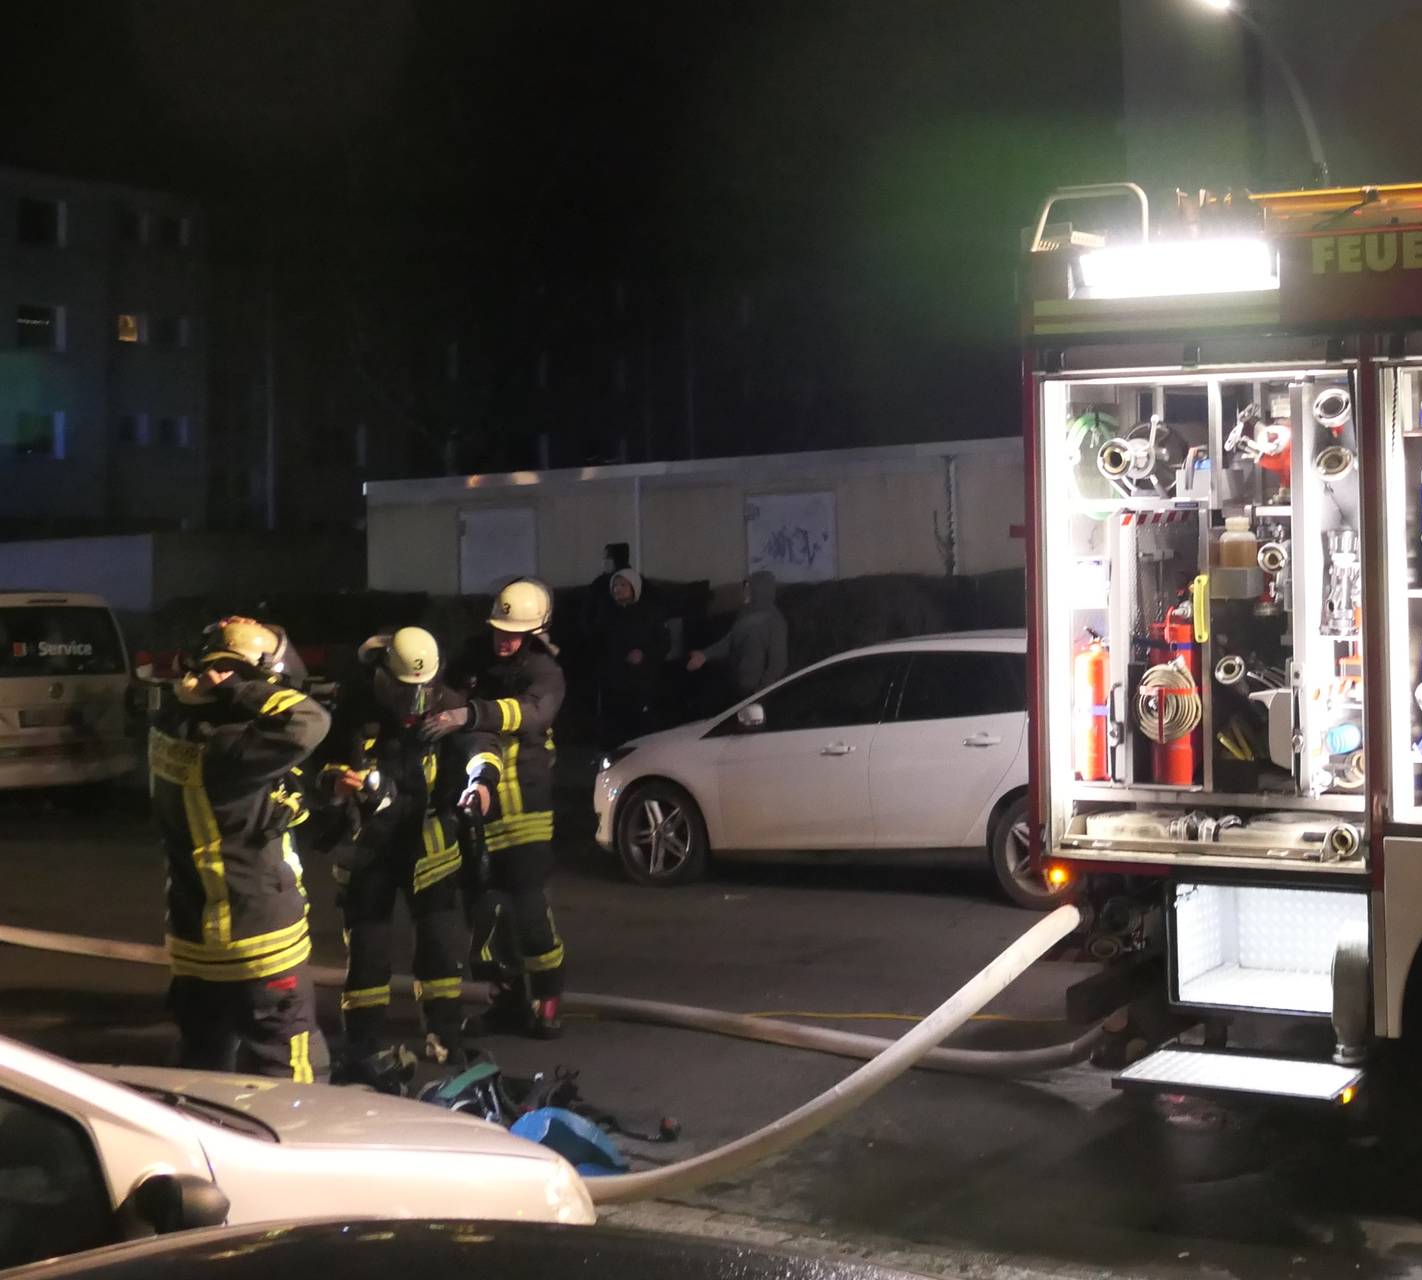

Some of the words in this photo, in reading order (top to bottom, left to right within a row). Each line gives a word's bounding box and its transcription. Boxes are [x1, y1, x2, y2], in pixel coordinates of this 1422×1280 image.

[503, 602, 511, 615] 3
[38, 641, 92, 656] Service
[413, 658, 424, 671] 3
